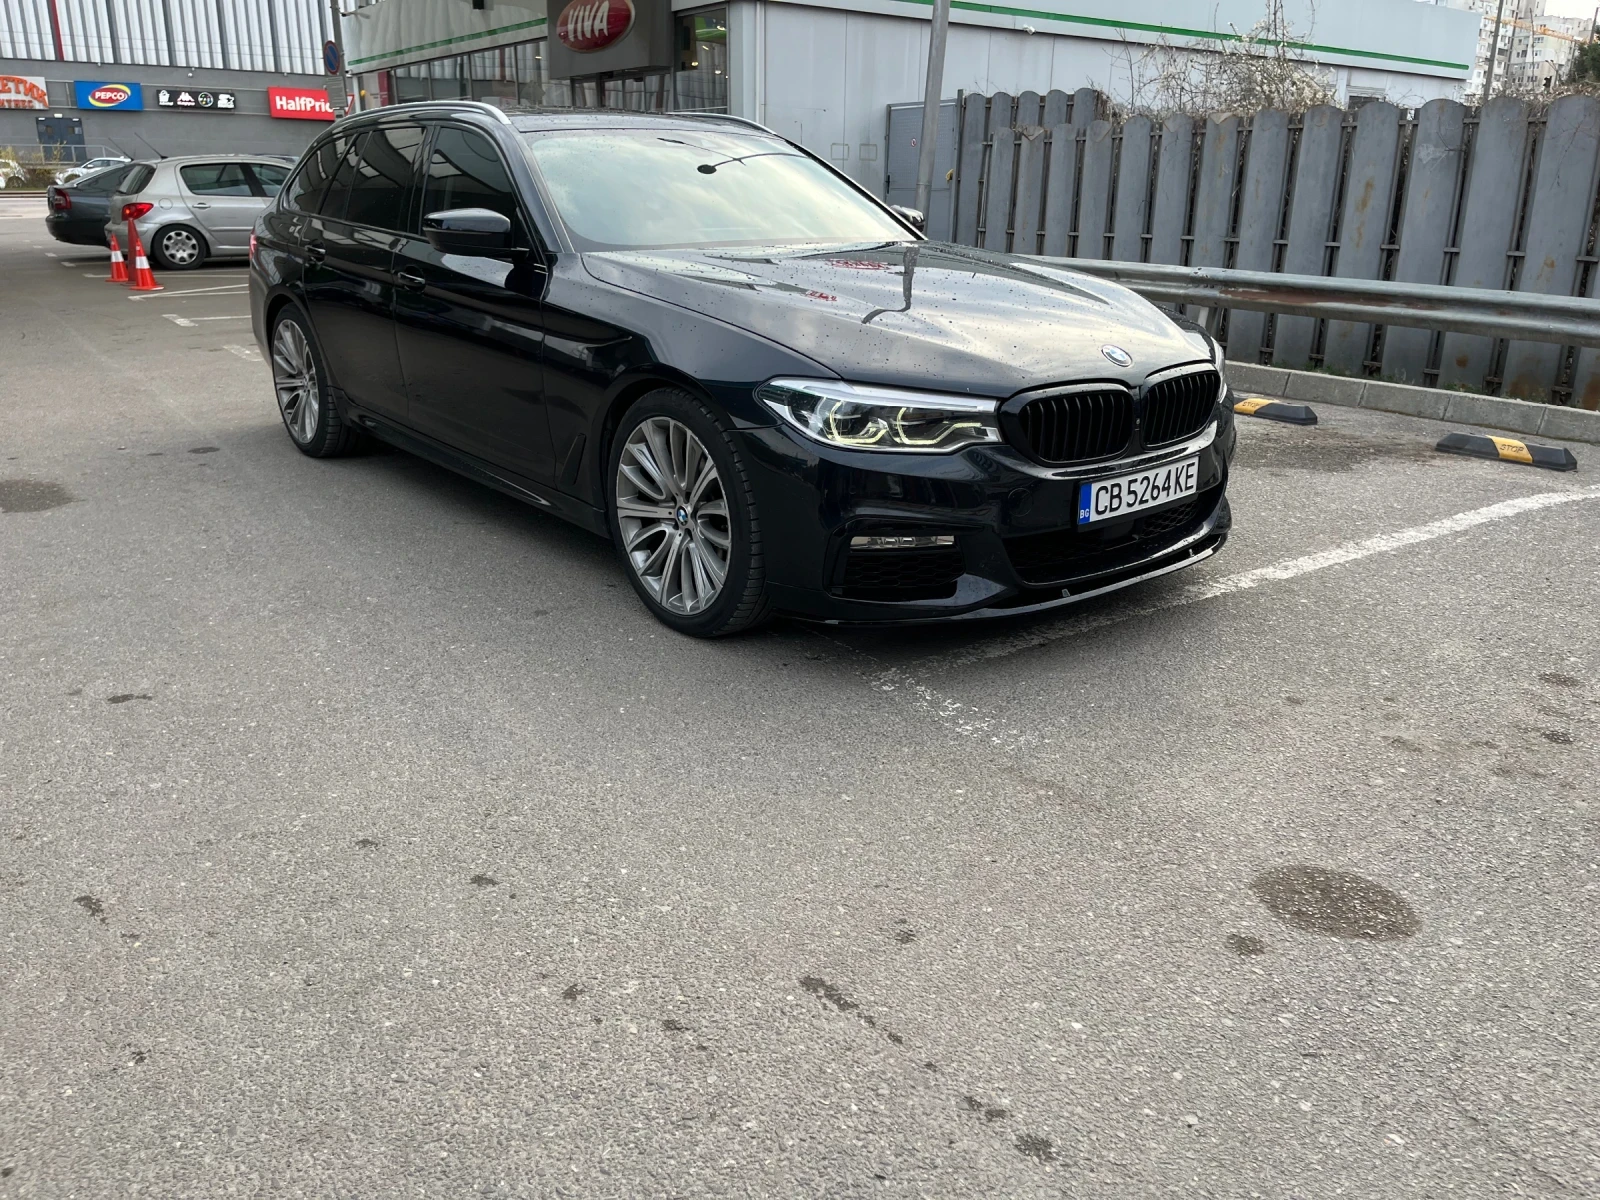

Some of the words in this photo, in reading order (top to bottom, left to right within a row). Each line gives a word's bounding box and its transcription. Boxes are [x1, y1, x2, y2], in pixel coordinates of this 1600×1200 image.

[567, 0, 610, 42] VIVA
[94, 91, 125, 100] PEPCO
[1500, 444, 1525, 453] STOP
[1095, 483, 1122, 515] CB
[1127, 469, 1171, 507] 5264
[1174, 462, 1196, 495] KE
[1080, 509, 1089, 518] BG
